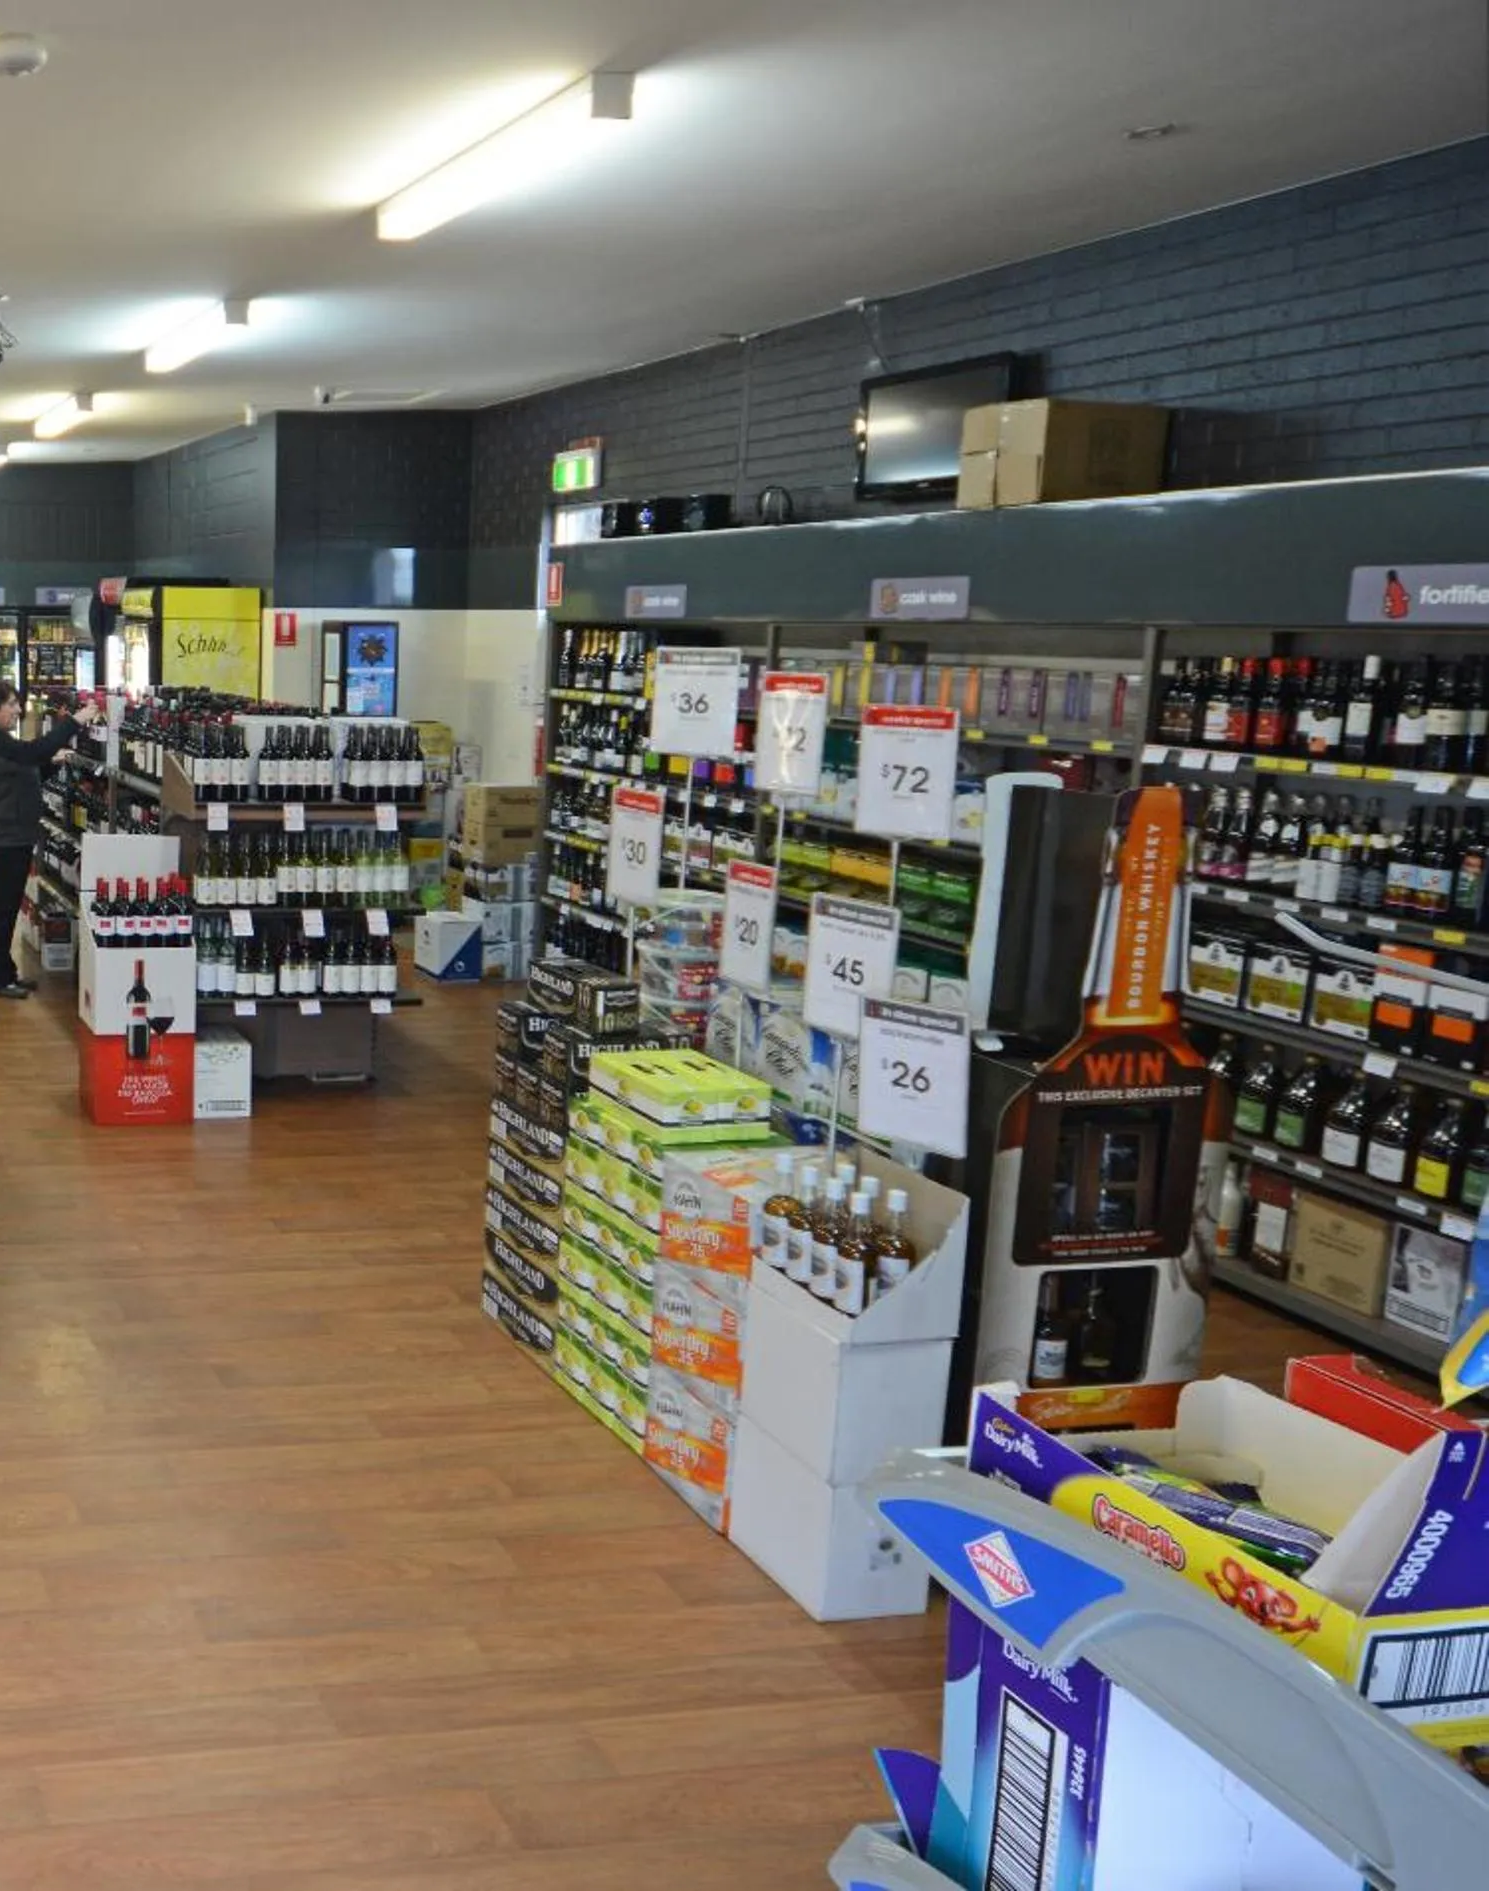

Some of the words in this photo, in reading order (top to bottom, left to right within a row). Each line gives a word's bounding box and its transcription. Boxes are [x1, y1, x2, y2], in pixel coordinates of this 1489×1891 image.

[881, 764, 930, 794] $72
[1126, 919, 1150, 1010] BOURBON
[1139, 823, 1162, 911] WHISKEY
[531, 965, 573, 996] HIGHLAND
[826, 953, 864, 985] $45
[883, 1058, 930, 1093] $26
[1084, 1052, 1167, 1086] WIN
[1065, 1089, 1124, 1101] EXCLUSIVE
[1126, 1087, 1180, 1099] DECANTER
[497, 1102, 550, 1145] HIGHLAND
[494, 1145, 547, 1193] HIGHLAND
[490, 1191, 546, 1242] HIGHLAND
[494, 1237, 545, 1290] HIGHLAND
[488, 1280, 539, 1336] HIGHLAND
[984, 1421, 1014, 1453] Dairy
[1013, 1432, 1043, 1469] Milk
[1093, 1494, 1185, 1570] Caramello
[1003, 1640, 1038, 1680] Dairy
[1041, 1663, 1078, 1703] Milk
